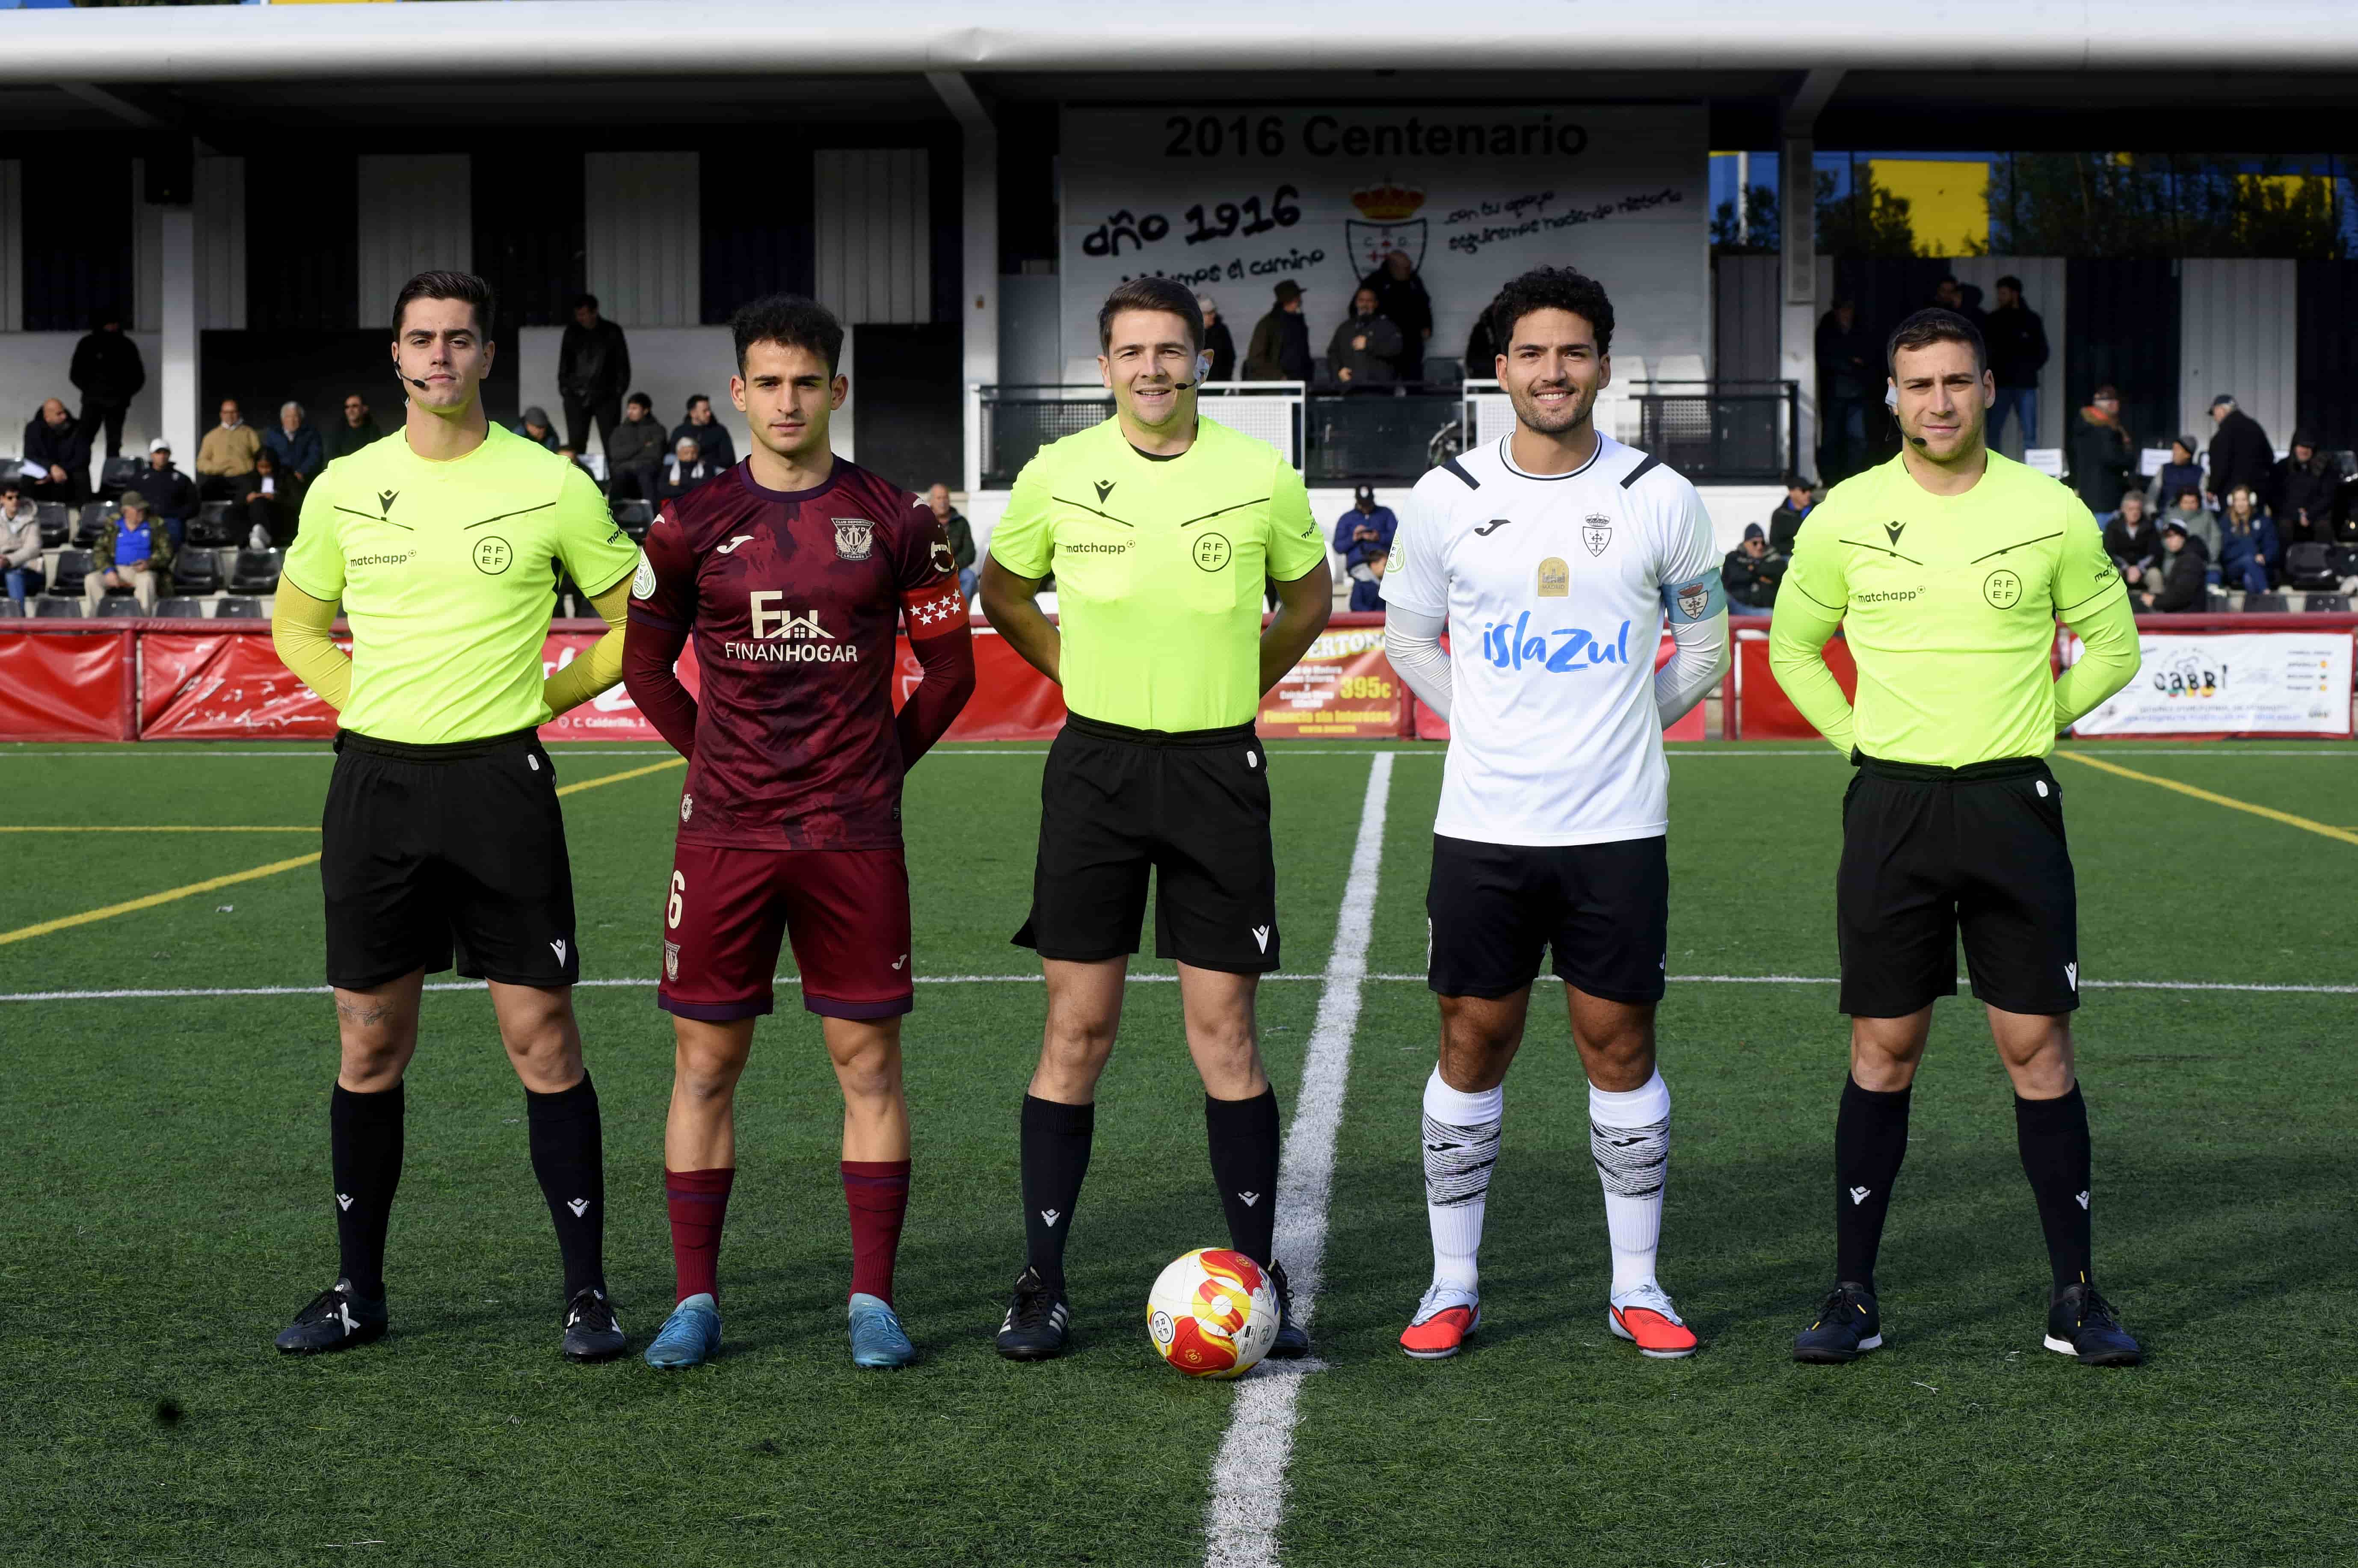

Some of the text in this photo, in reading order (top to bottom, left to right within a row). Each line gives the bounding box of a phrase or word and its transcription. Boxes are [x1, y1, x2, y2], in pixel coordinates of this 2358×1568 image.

[1165, 115, 1588, 156] 2016 Centenario
[1185, 185, 1299, 244] 1916
[1250, 249, 1324, 275] camino
[350, 554, 407, 567] matchapp
[1066, 542, 1126, 554] matchapp
[1858, 591, 1916, 603] matchapp
[725, 642, 858, 662] FINANHOGAR
[1484, 611, 1631, 673] islaZul
[669, 870, 685, 929] 6
